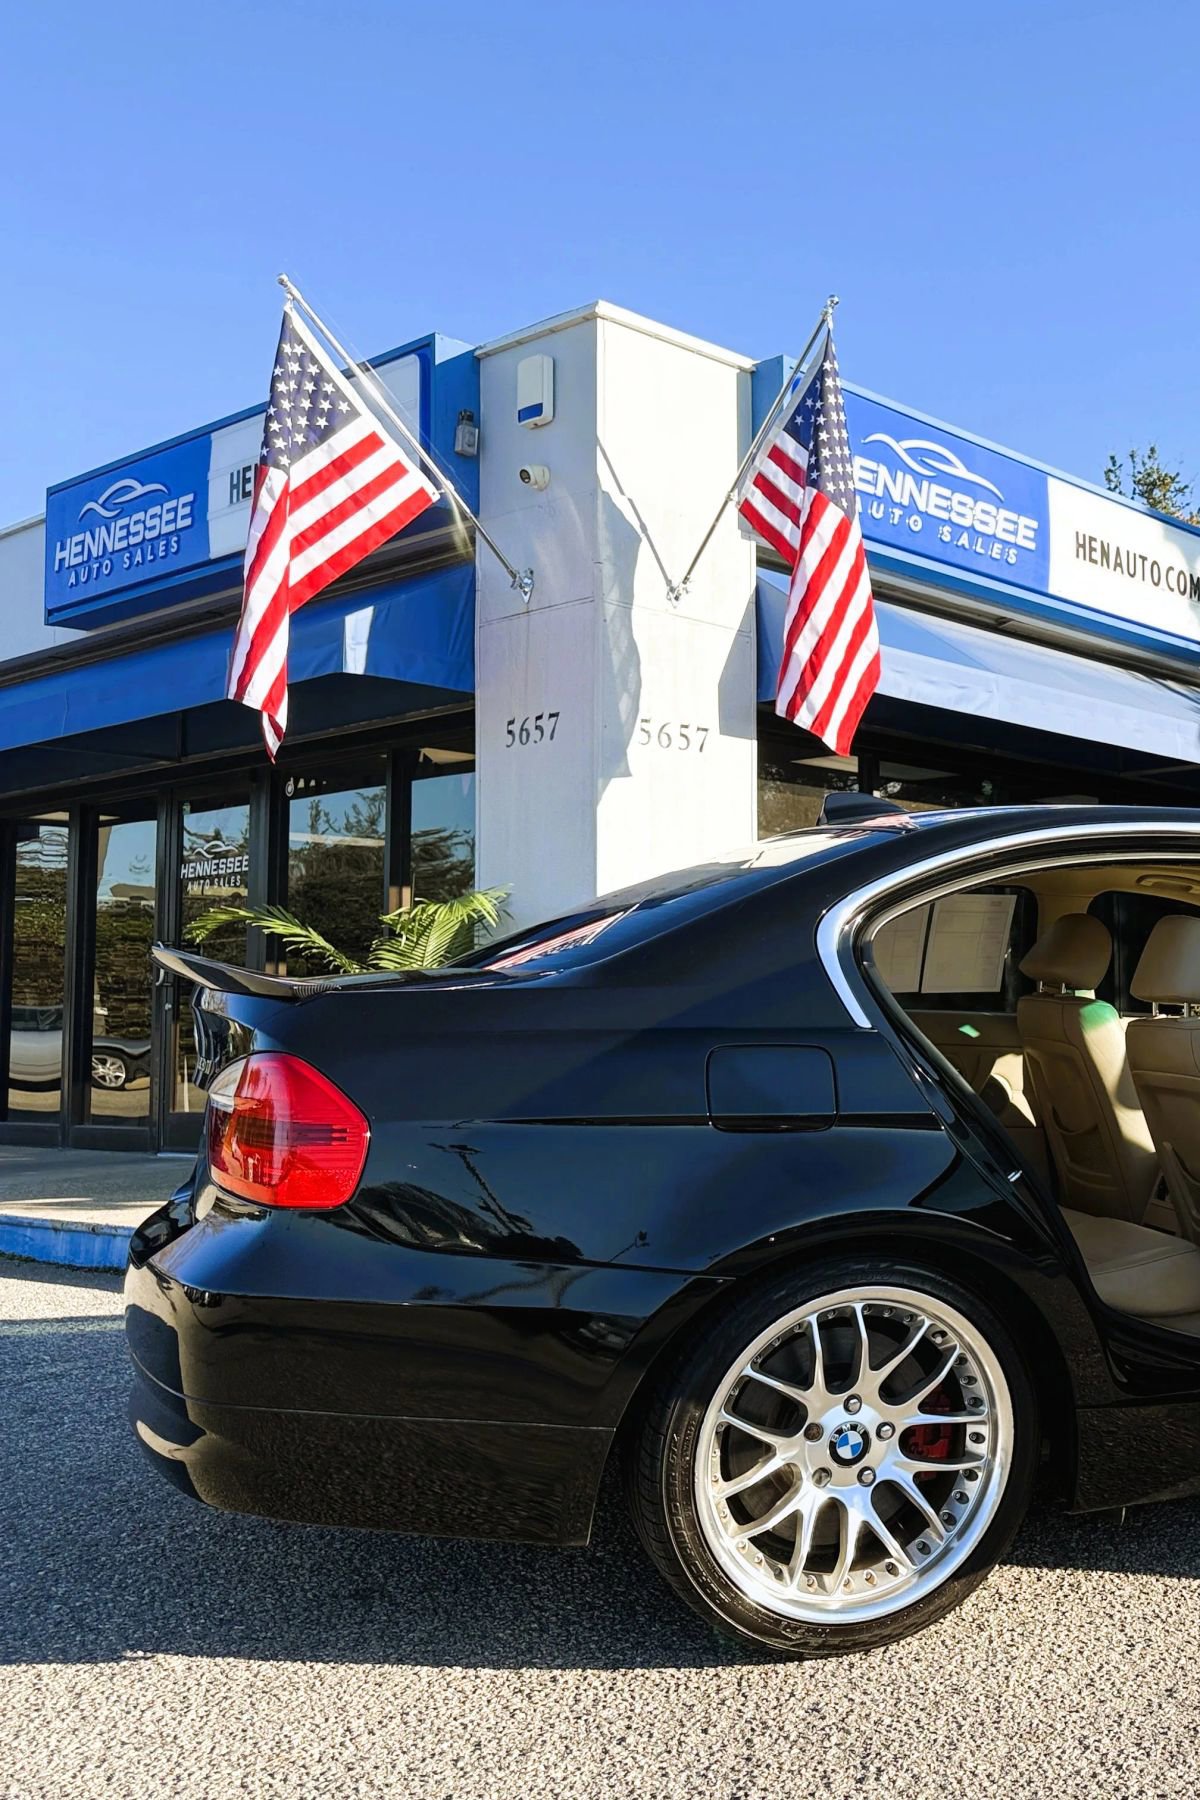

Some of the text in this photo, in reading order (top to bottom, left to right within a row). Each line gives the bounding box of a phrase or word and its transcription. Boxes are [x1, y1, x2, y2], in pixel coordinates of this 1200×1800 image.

[853, 455, 1039, 551] ENNESSEE
[54, 492, 195, 572] HENNESSEE
[938, 525, 1017, 565] SALES
[68, 537, 179, 587] AUTO SALES
[505, 711, 560, 748] 5657
[639, 718, 709, 753] 5657
[180, 855, 249, 879] HENNESSEE
[187, 875, 241, 892] AUTO SALES
[831, 1423, 865, 1442] BMW
